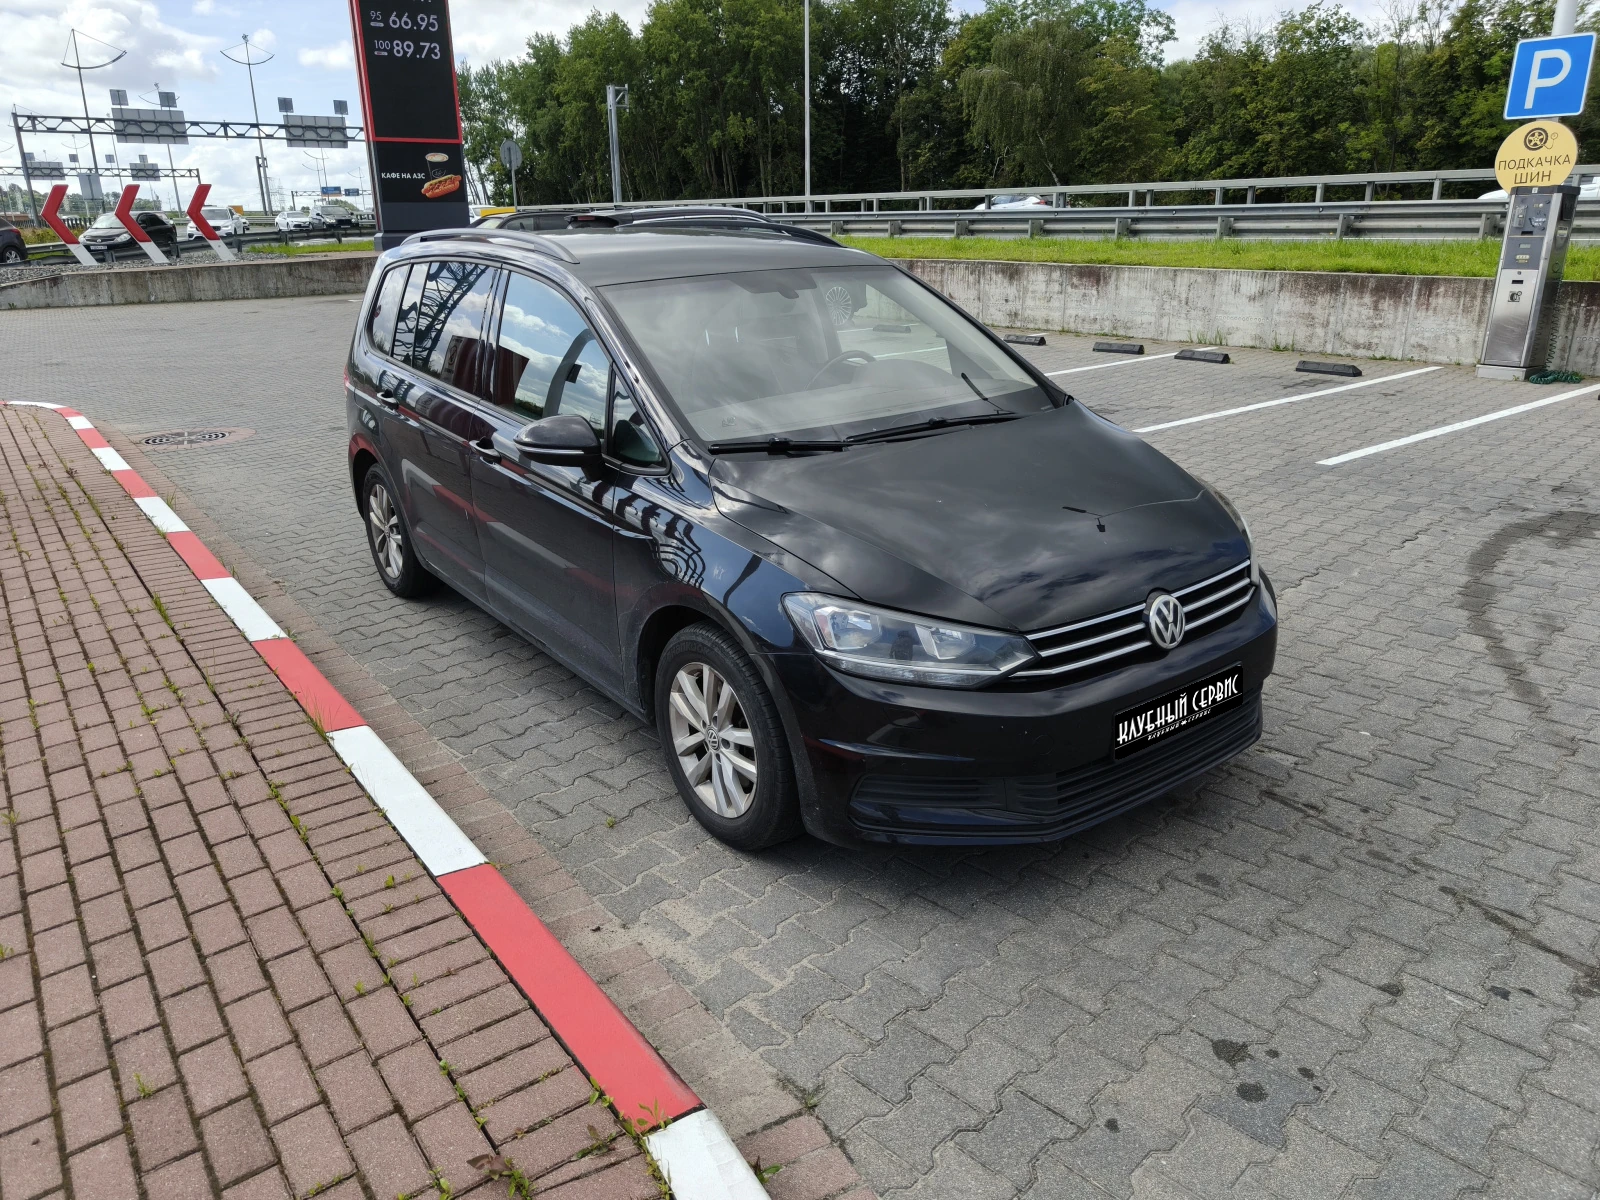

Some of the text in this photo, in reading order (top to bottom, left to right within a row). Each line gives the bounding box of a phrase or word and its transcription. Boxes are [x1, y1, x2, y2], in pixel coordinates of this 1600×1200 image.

[370, 10, 439, 32] 95 66.95
[374, 39, 441, 60] 100 89.73
[1524, 48, 1572, 110] P
[1498, 154, 1571, 171] ПОДКАЧКА
[1514, 170, 1552, 185] ШИН
